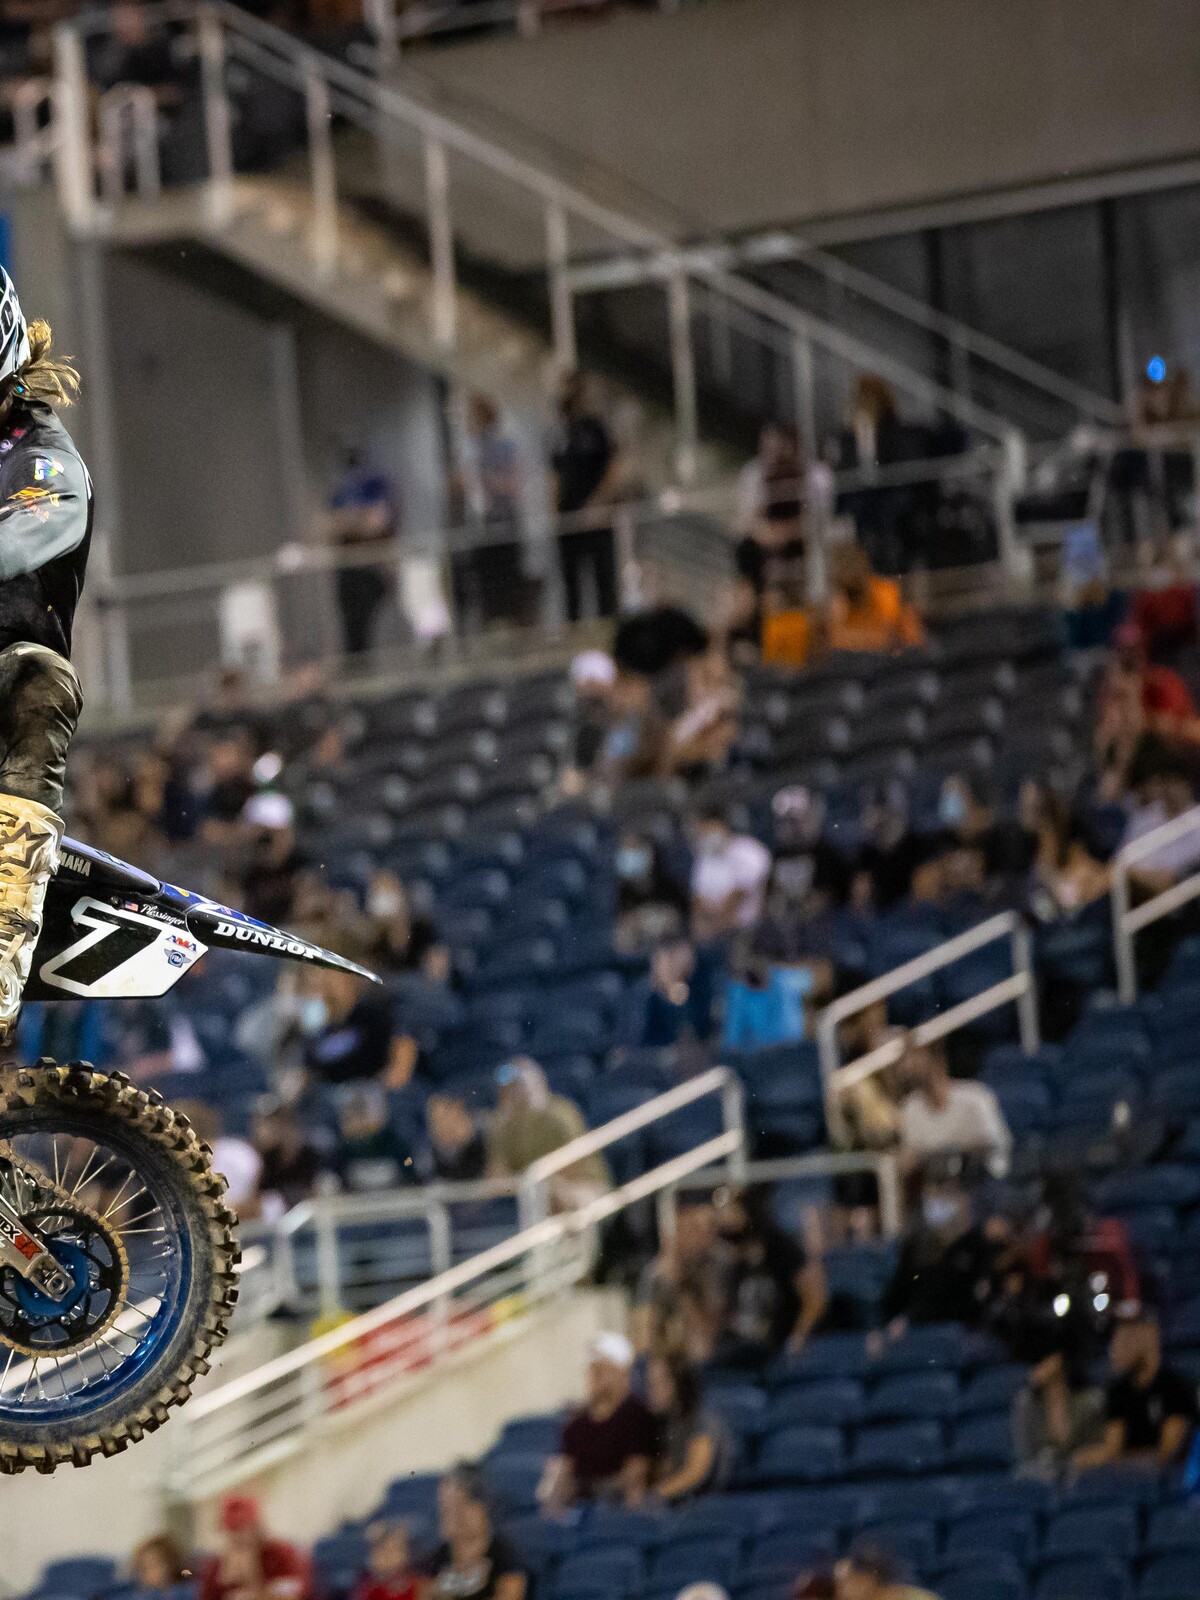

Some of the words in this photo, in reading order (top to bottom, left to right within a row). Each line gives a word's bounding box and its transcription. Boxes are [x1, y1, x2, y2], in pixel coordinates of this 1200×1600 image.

[59, 851, 92, 877] MAHA
[140, 903, 185, 926] Plessinger
[51, 906, 163, 987] 7
[165, 935, 197, 953] AMA
[213, 921, 322, 960] DUNLOP
